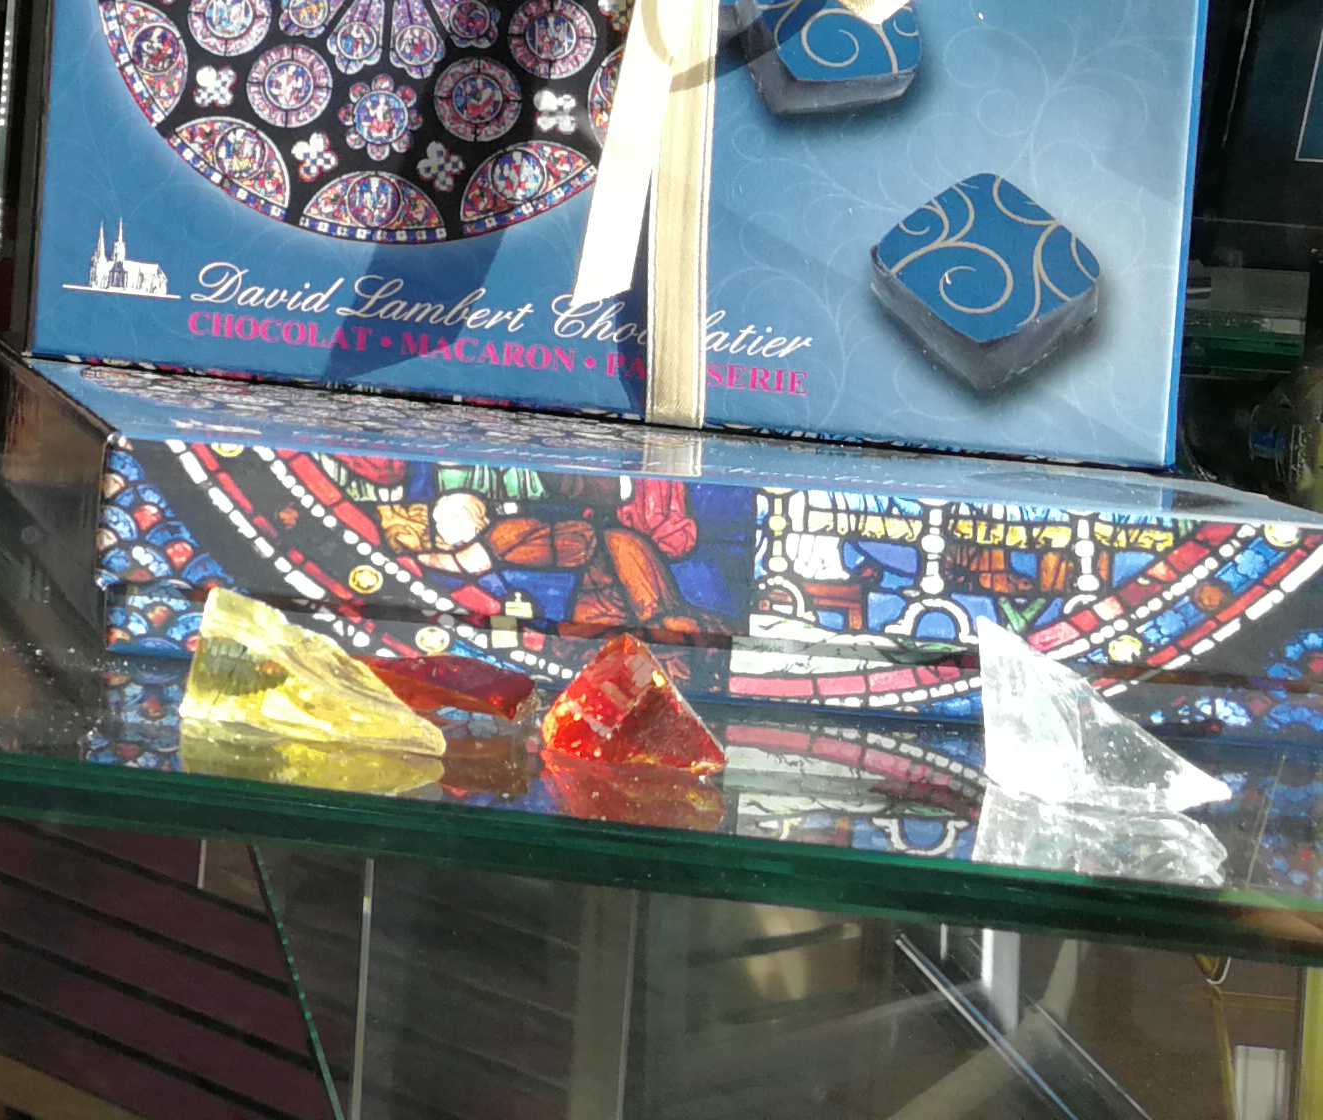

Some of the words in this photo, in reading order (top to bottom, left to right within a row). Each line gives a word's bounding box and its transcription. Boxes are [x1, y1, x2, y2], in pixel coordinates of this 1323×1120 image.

[188, 311, 372, 351] CHOCOLAT
[401, 332, 576, 372] MACARON
[605, 352, 809, 396] PASERIE
[190, 262, 345, 313] David
[336, 275, 534, 333] Lambert
[551, 294, 812, 357] Choclatier
